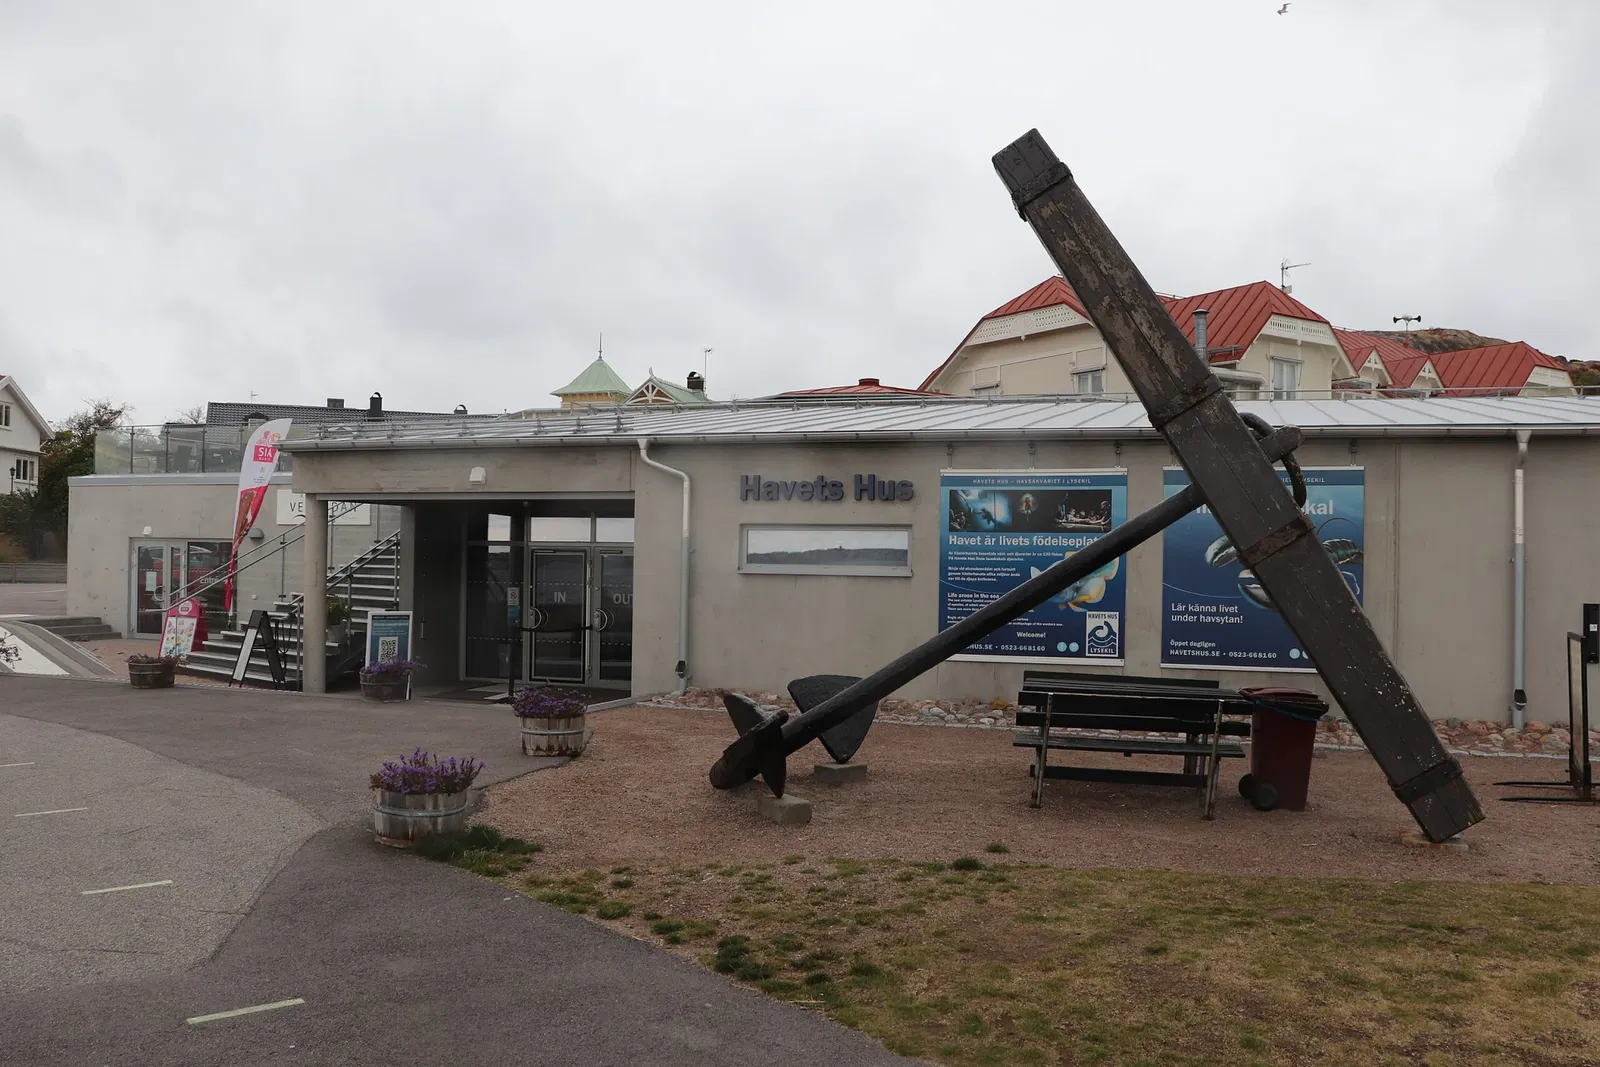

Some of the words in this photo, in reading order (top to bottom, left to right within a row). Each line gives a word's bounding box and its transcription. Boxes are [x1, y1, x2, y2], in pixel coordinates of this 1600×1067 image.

[258, 447, 272, 458] SIA
[740, 475, 844, 501] Havets
[854, 474, 914, 501] Hus
[1305, 500, 1334, 514] kal
[949, 535, 982, 545] Havet
[984, 535, 996, 545] är
[1000, 536, 1030, 546] livets
[1032, 536, 1100, 548] födelseplat
[554, 592, 566, 602] IN
[1171, 603, 1186, 611] Lär
[1188, 603, 1216, 612] känna
[1219, 604, 1238, 613] livet
[1171, 614, 1198, 622] under
[1199, 614, 1243, 625] havsytan!
[967, 643, 992, 651] HUS.SE
[1170, 639, 1188, 647] Öppet
[1189, 640, 1216, 648] dagligen
[1170, 649, 1220, 657] HAVETSHUS.SE
